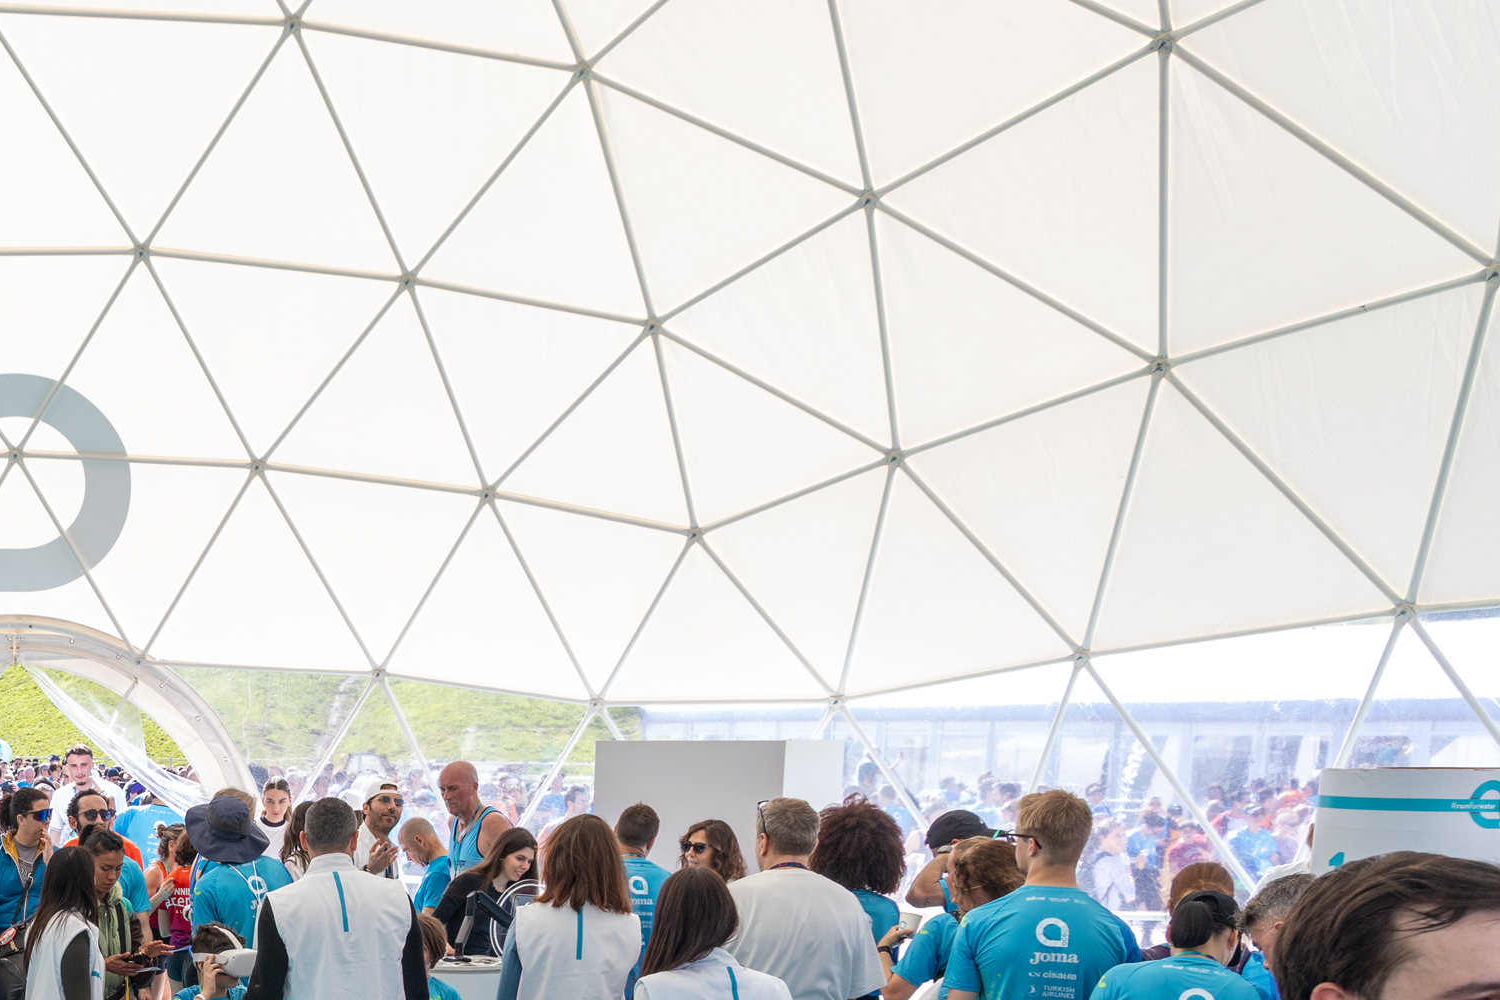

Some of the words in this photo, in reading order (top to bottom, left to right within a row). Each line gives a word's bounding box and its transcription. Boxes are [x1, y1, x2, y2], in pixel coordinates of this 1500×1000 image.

[1450, 801, 1496, 810] #runforwater
[1029, 952, 1079, 965] Joma
[1042, 970, 1077, 980] cisalfa
[1043, 985, 1076, 993] TURKISH
[1042, 991, 1075, 1000] AIRLINES
